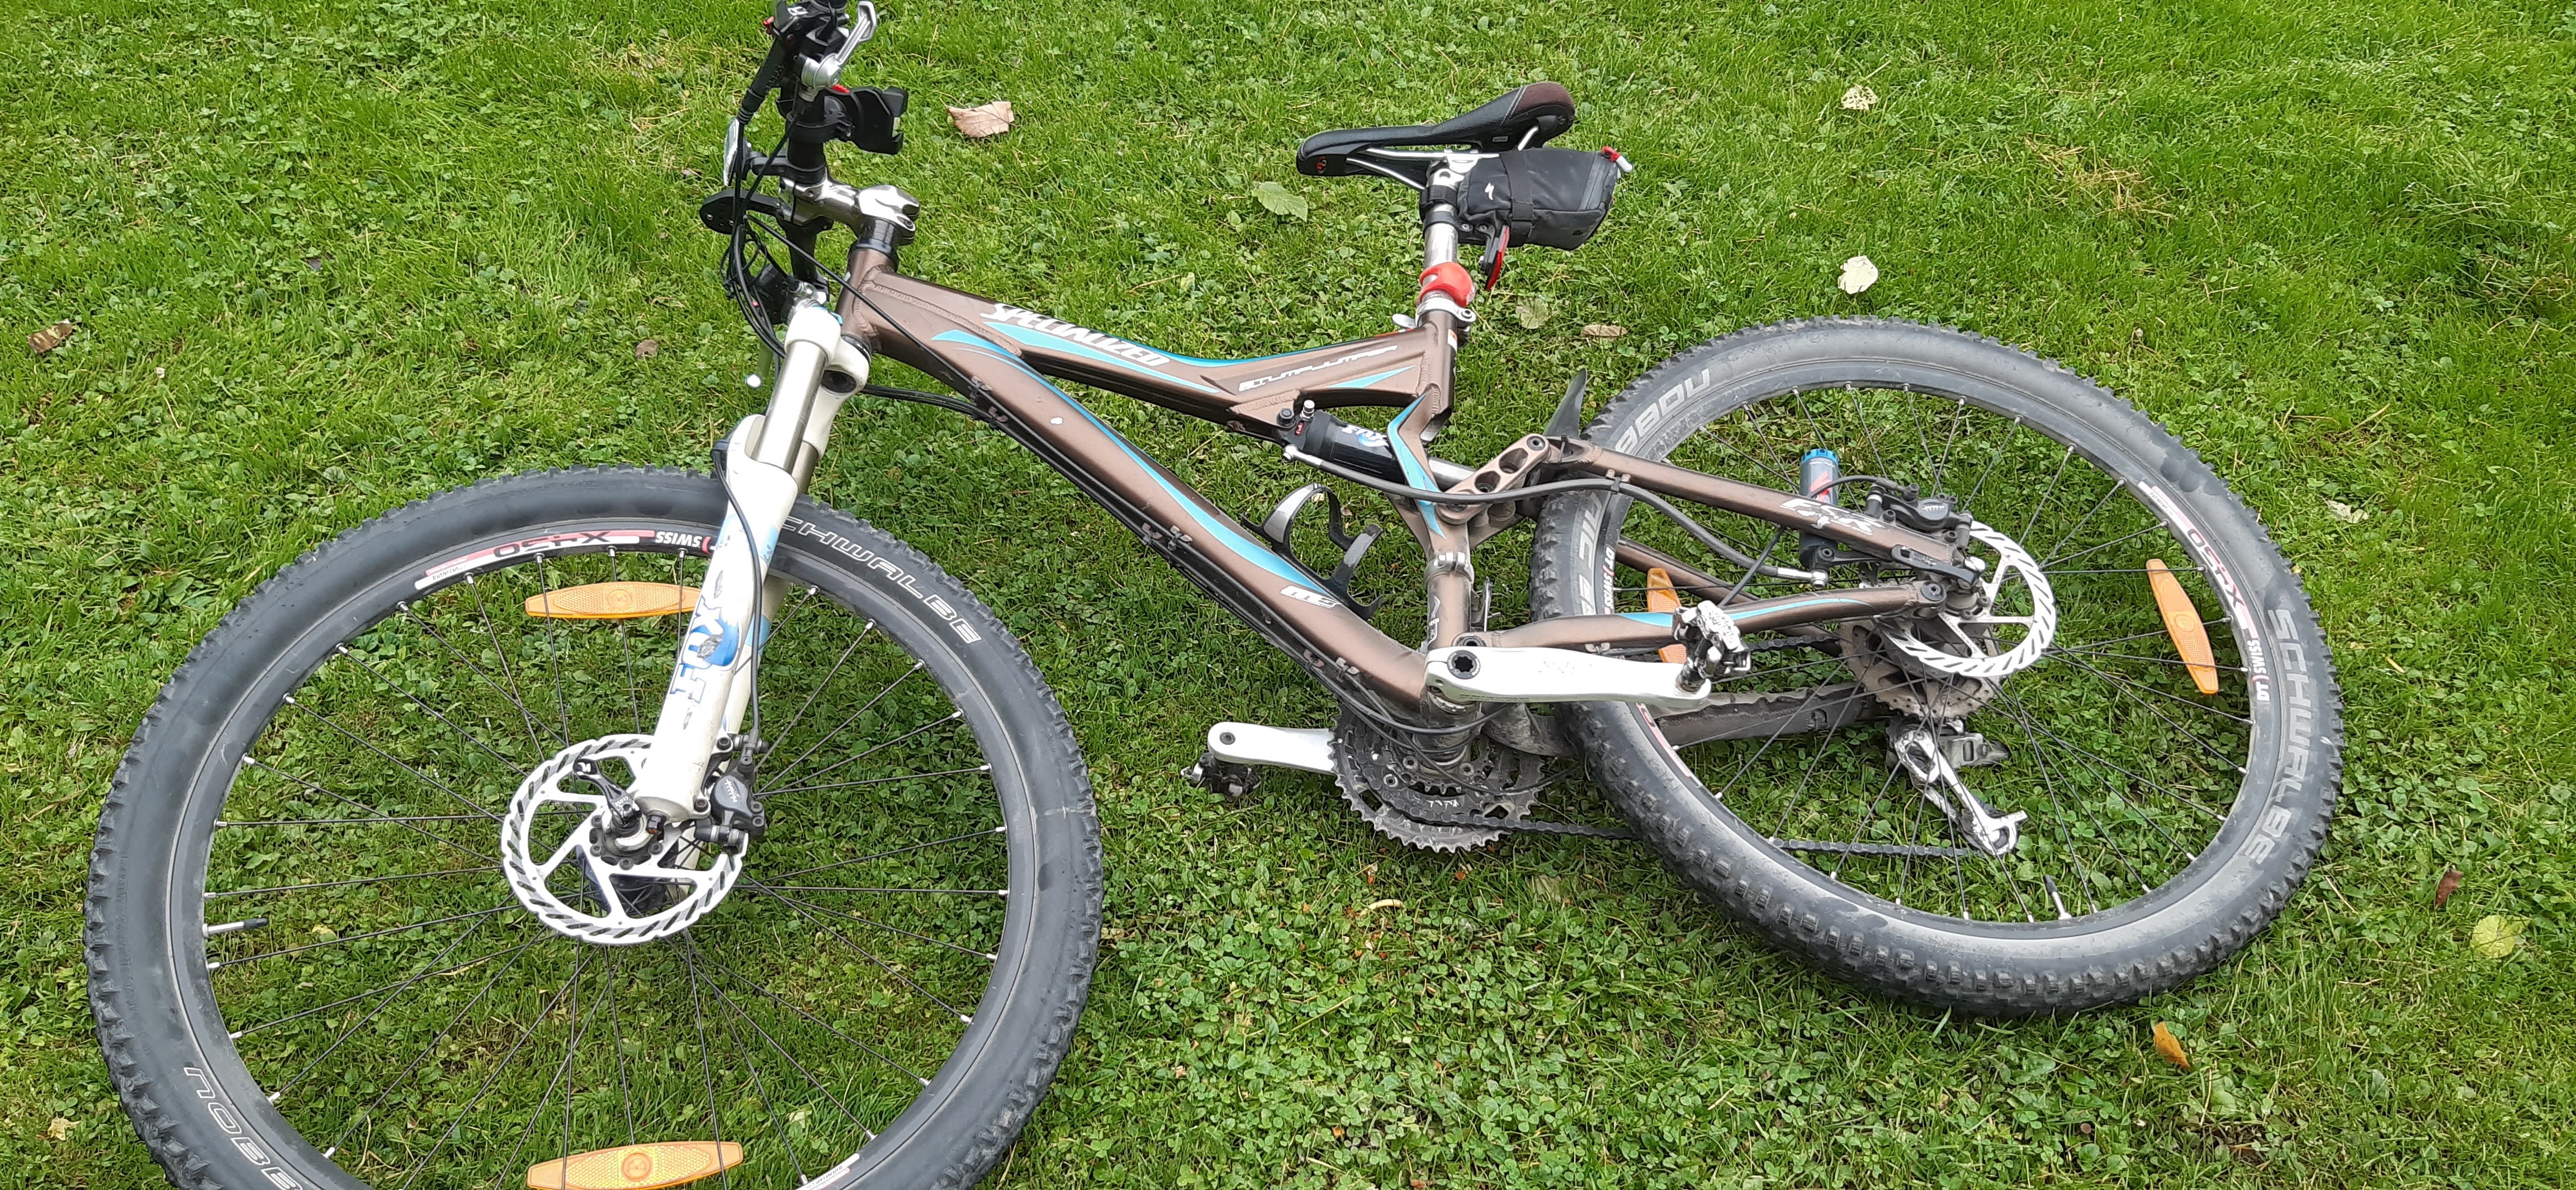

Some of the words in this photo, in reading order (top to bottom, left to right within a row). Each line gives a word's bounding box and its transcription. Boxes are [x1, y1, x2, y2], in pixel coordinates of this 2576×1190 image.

[981, 303, 1170, 366] SPECIALIZED
[655, 532, 703, 548] SWISS
[1604, 546, 1616, 566] DT
[782, 516, 982, 644] CHWALBE
[1603, 572, 1615, 610] SWISS
[670, 597, 724, 705] FOX
[2247, 640, 2267, 674] SWISS
[2256, 681, 2270, 701] DT
[2243, 609, 2313, 865] SCHWALBE
